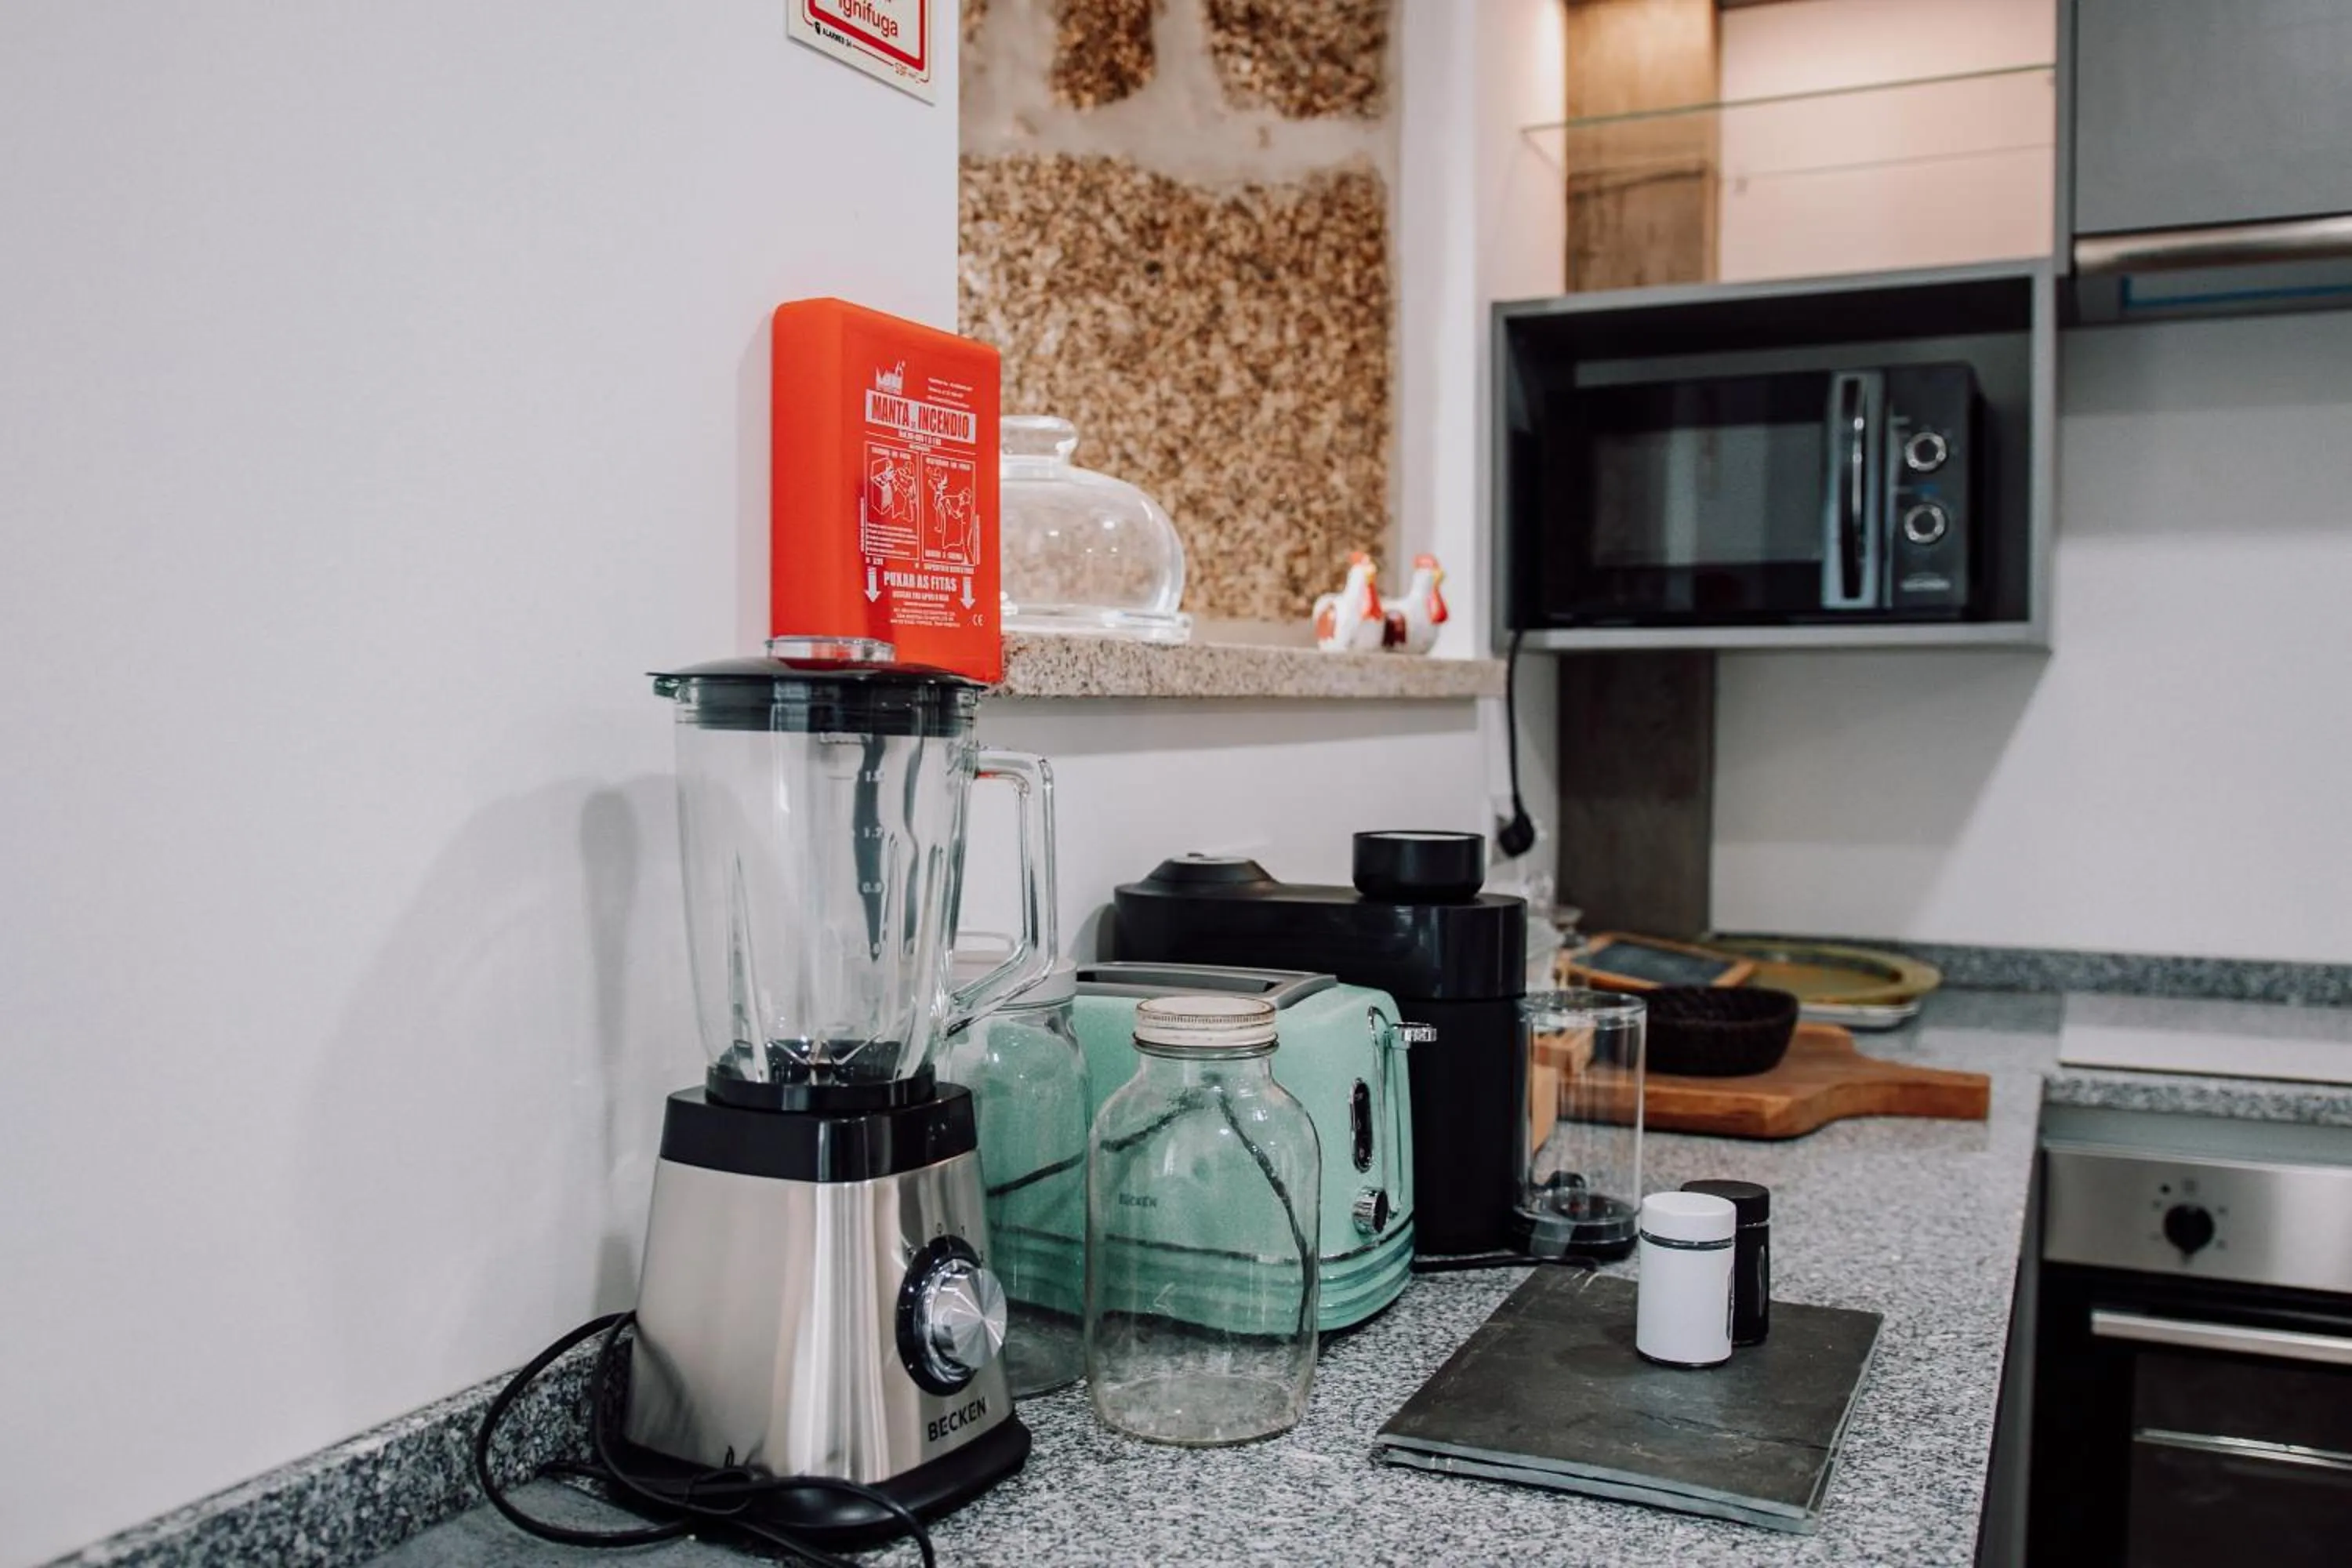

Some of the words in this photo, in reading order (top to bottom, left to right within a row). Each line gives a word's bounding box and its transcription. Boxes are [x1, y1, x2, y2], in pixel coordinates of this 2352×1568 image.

[872, 394, 909, 427] MANTA
[918, 405, 970, 439] INCENDIO
[916, 574, 929, 590] AS
[931, 575, 957, 592] FITAS
[972, 614, 984, 626] CE
[927, 1396, 987, 1442] BECKEN
